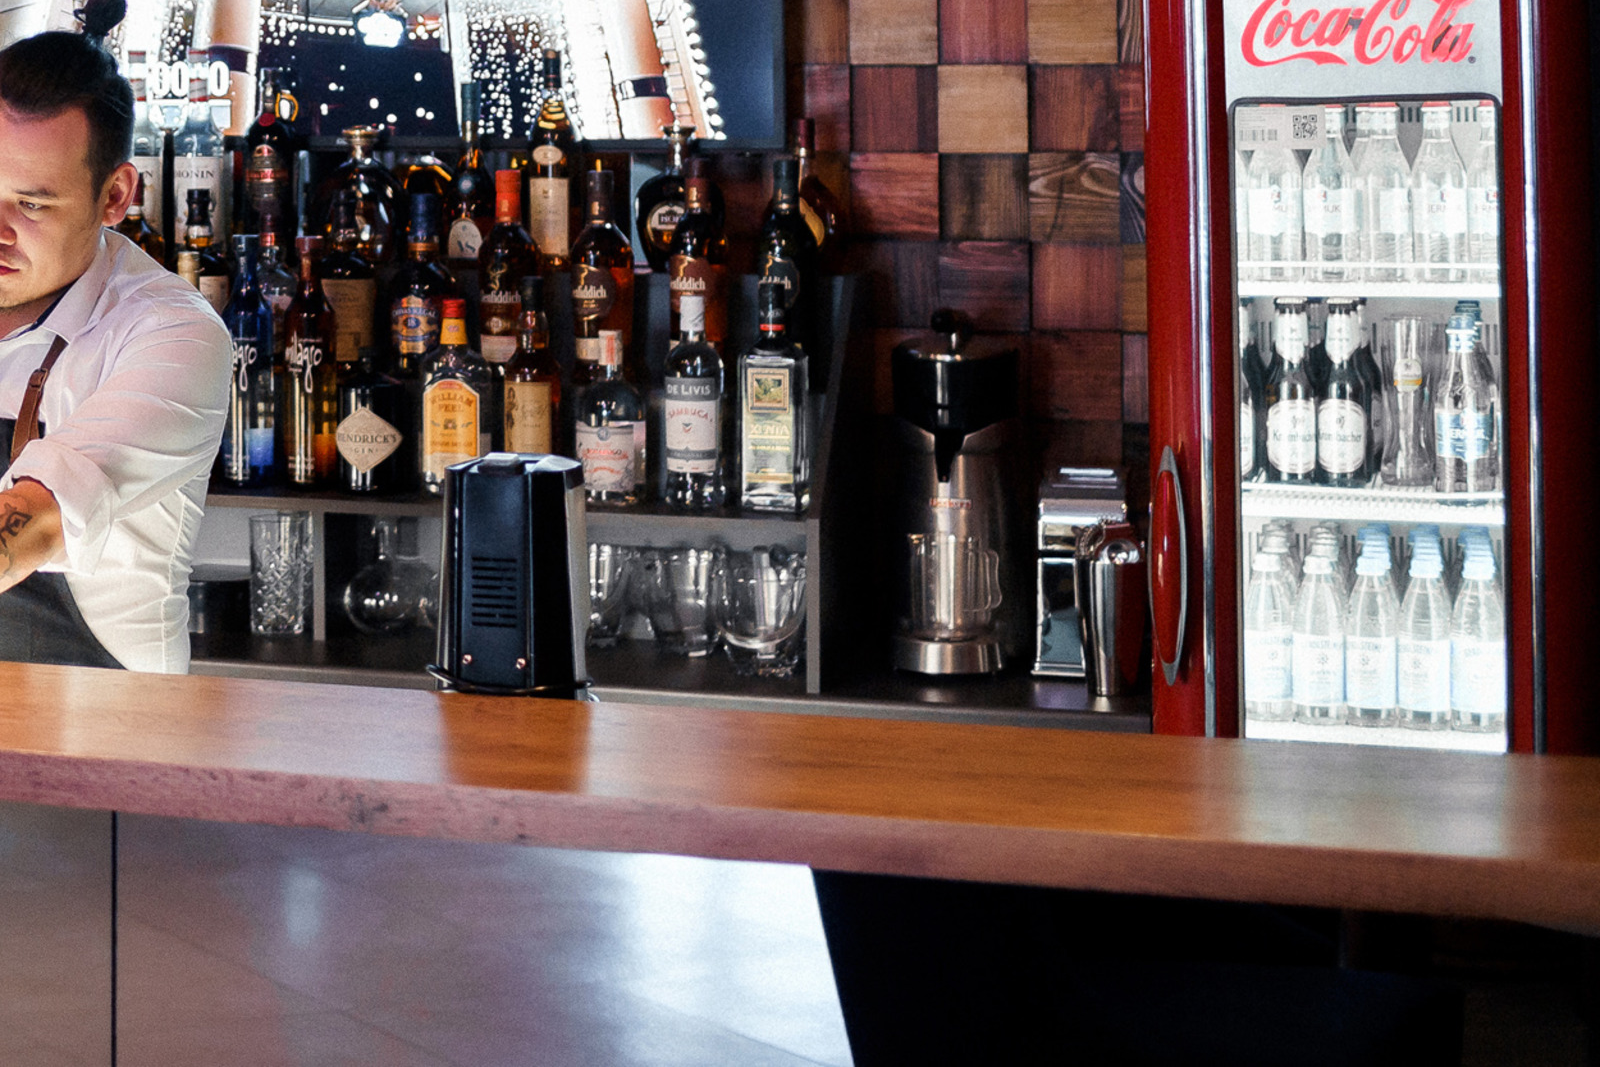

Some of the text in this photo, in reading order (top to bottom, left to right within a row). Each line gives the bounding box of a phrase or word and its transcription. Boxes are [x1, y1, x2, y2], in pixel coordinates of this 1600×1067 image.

[667, 384, 711, 396] DE LIVIS
[431, 392, 474, 406] WILLIAM
[439, 404, 464, 412] PEEL
[337, 434, 397, 444] HENDRICK'S
